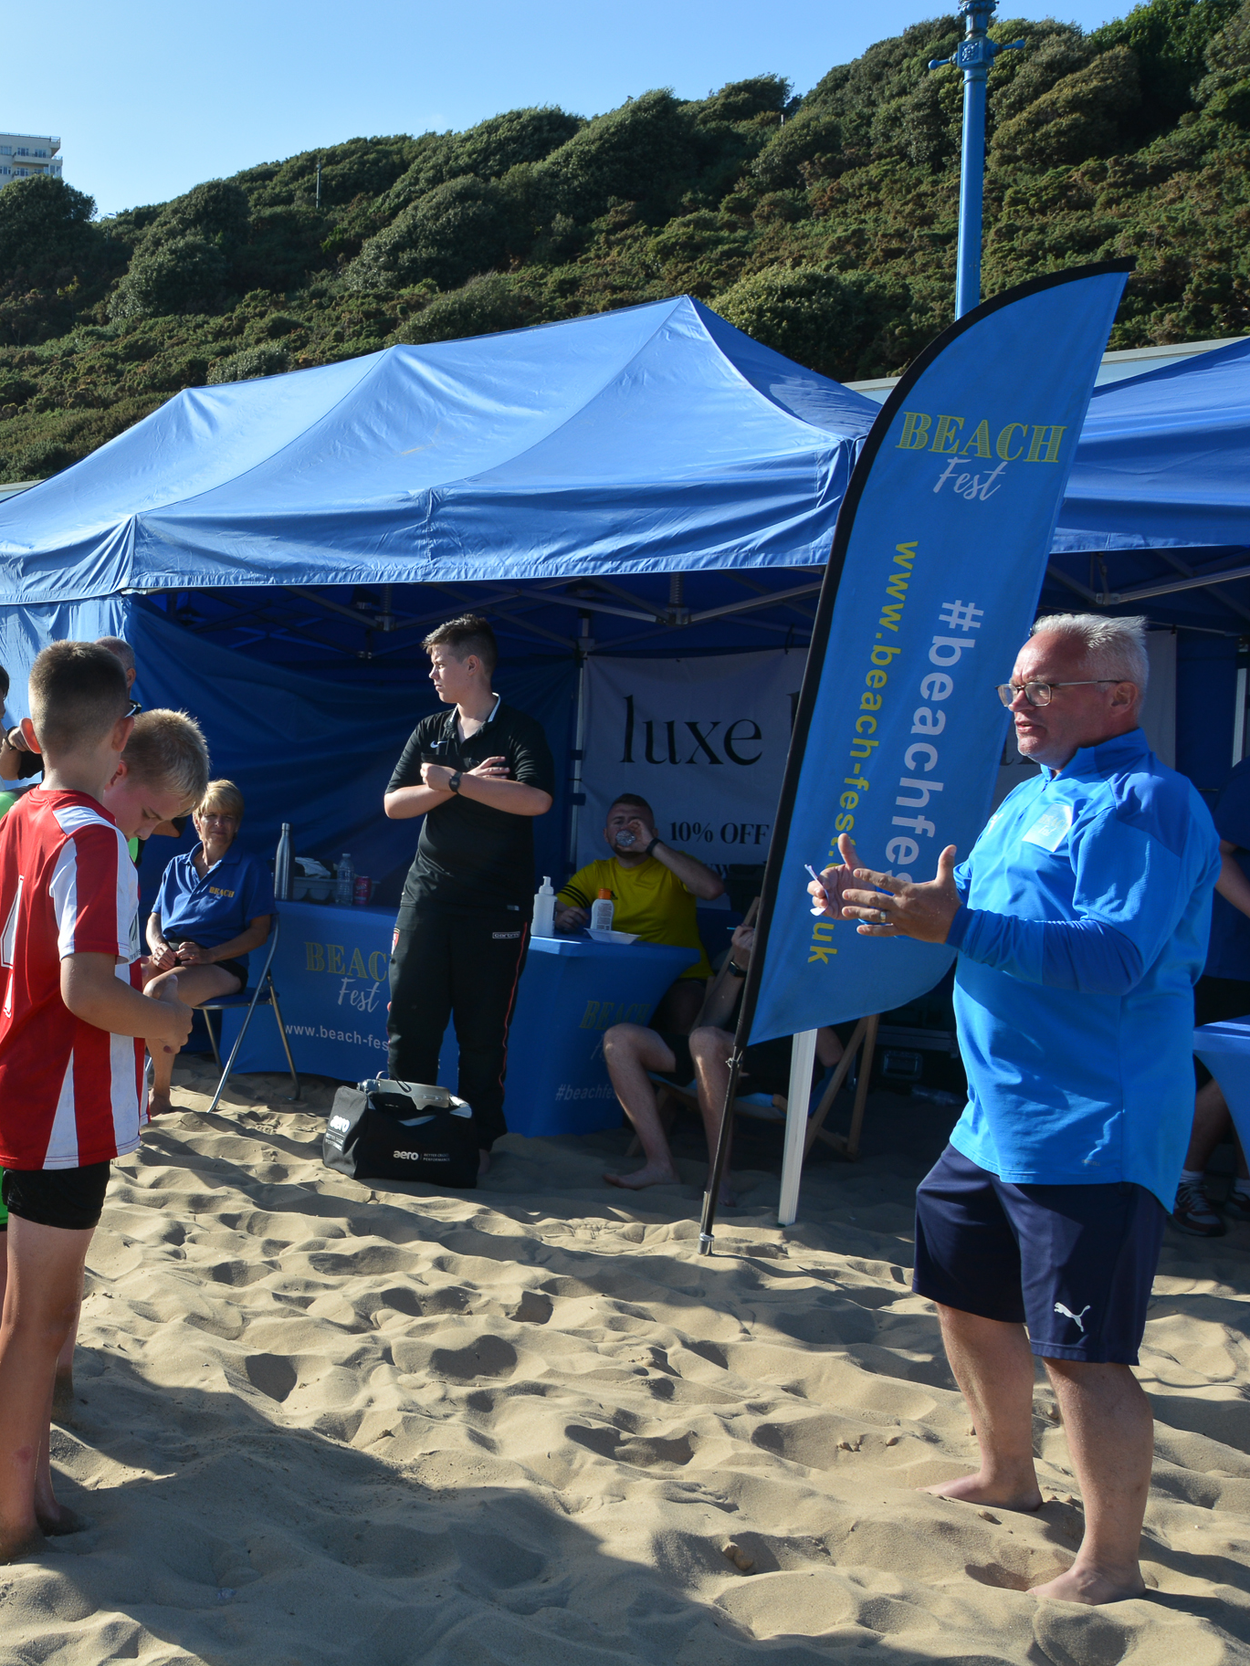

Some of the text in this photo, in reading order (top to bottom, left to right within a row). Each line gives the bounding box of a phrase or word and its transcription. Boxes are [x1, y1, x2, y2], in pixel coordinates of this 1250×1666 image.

[895, 411, 1068, 463] BEACH
[933, 457, 1008, 501] Fest
[619, 694, 763, 766] luxe
[670, 821, 770, 845] 10% OFF
[304, 941, 391, 982] BEAC
[337, 977, 380, 1013] Fest
[285, 1024, 389, 1052] www.beach-fes
[393, 1150, 419, 1161] aero
